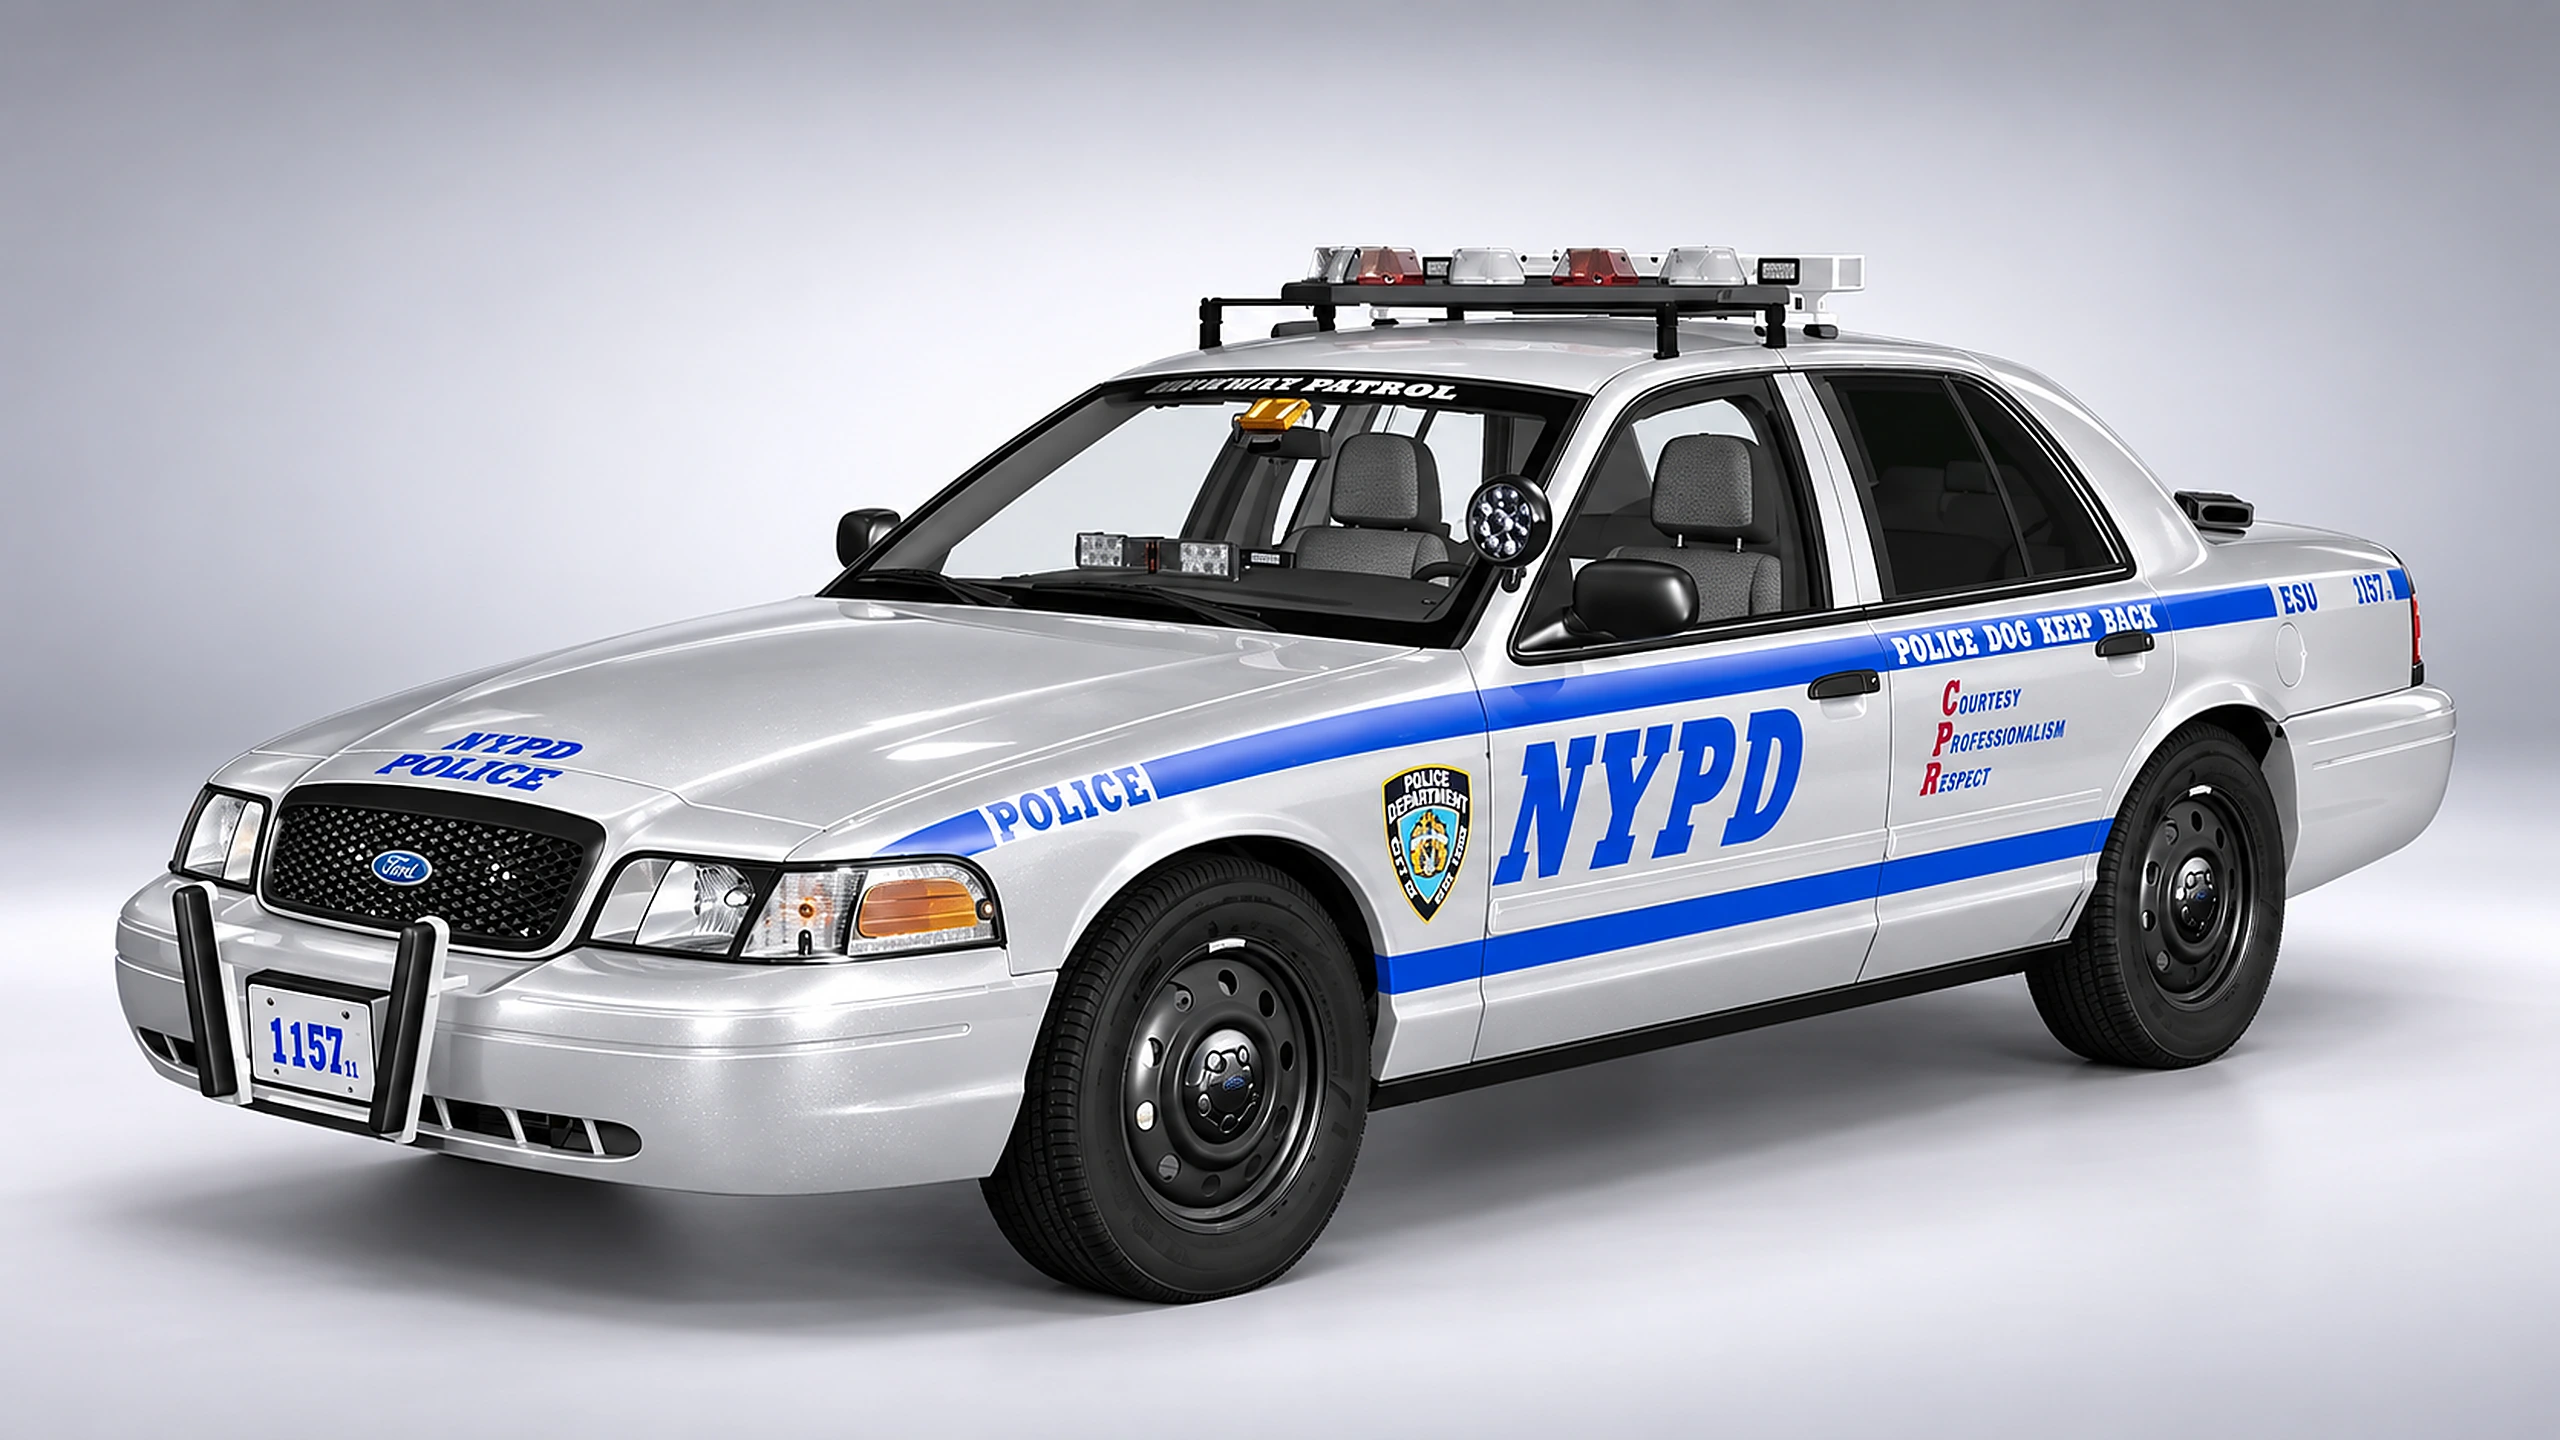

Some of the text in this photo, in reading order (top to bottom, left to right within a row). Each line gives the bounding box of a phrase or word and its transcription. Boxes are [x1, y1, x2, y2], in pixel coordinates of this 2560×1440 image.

[1300, 378, 1457, 400] PATROL
[2278, 582, 2318, 615] ESU
[2353, 573, 2384, 604] 1157
[1890, 604, 2158, 665] POLICE DOG KEEP BACK
[1942, 679, 2022, 717] COURTESY
[441, 732, 584, 760] NYPD
[1932, 719, 2066, 757] PROFESSIONALISM
[374, 754, 564, 792] POLICE
[1403, 769, 1450, 793] POLICE
[1919, 762, 1992, 796] RESPECT
[985, 766, 1152, 843] POLICE
[1492, 708, 1804, 886] NYPD
[381, 855, 419, 879] Ford
[270, 1017, 359, 1079] 1157 11
